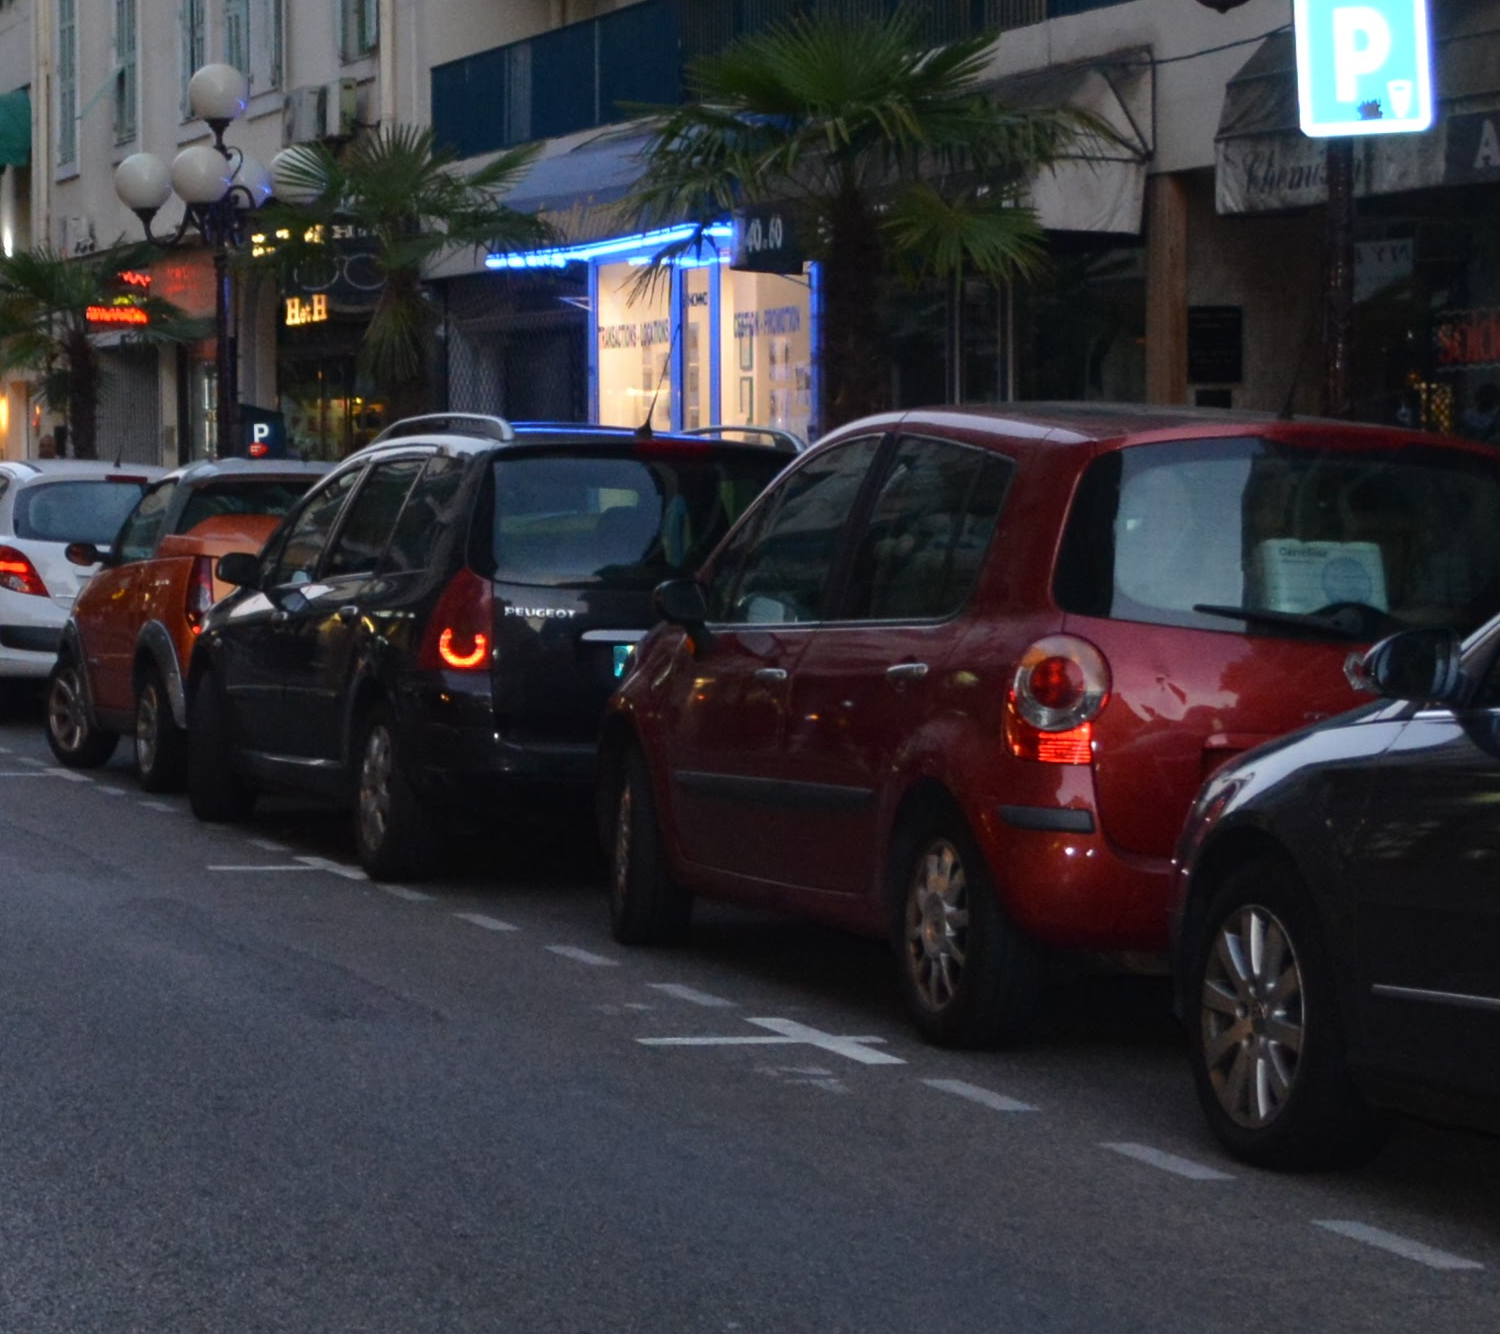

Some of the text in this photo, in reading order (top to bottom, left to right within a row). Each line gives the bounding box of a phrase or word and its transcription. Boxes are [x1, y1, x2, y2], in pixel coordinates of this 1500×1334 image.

[1332, 6, 1391, 103] P
[253, 423, 269, 443] P
[504, 606, 576, 619] PEUGEOT
